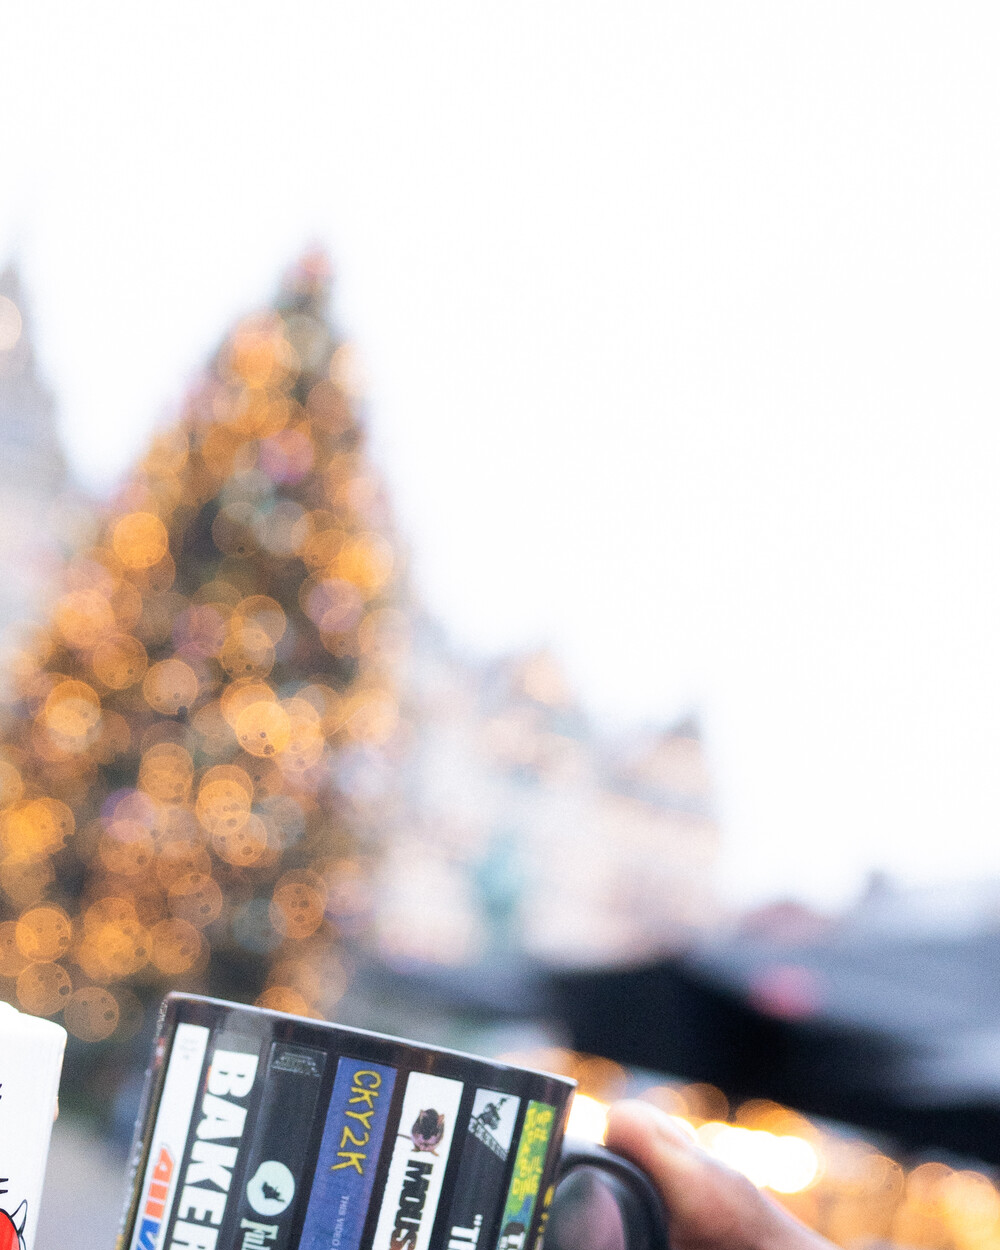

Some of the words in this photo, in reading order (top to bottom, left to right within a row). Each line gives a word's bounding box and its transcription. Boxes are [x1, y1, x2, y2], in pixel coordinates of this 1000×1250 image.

[332, 1070, 381, 1173] CKY2K
[338, 1195, 349, 1215] THIS
[331, 1217, 344, 1246] VIDEO
